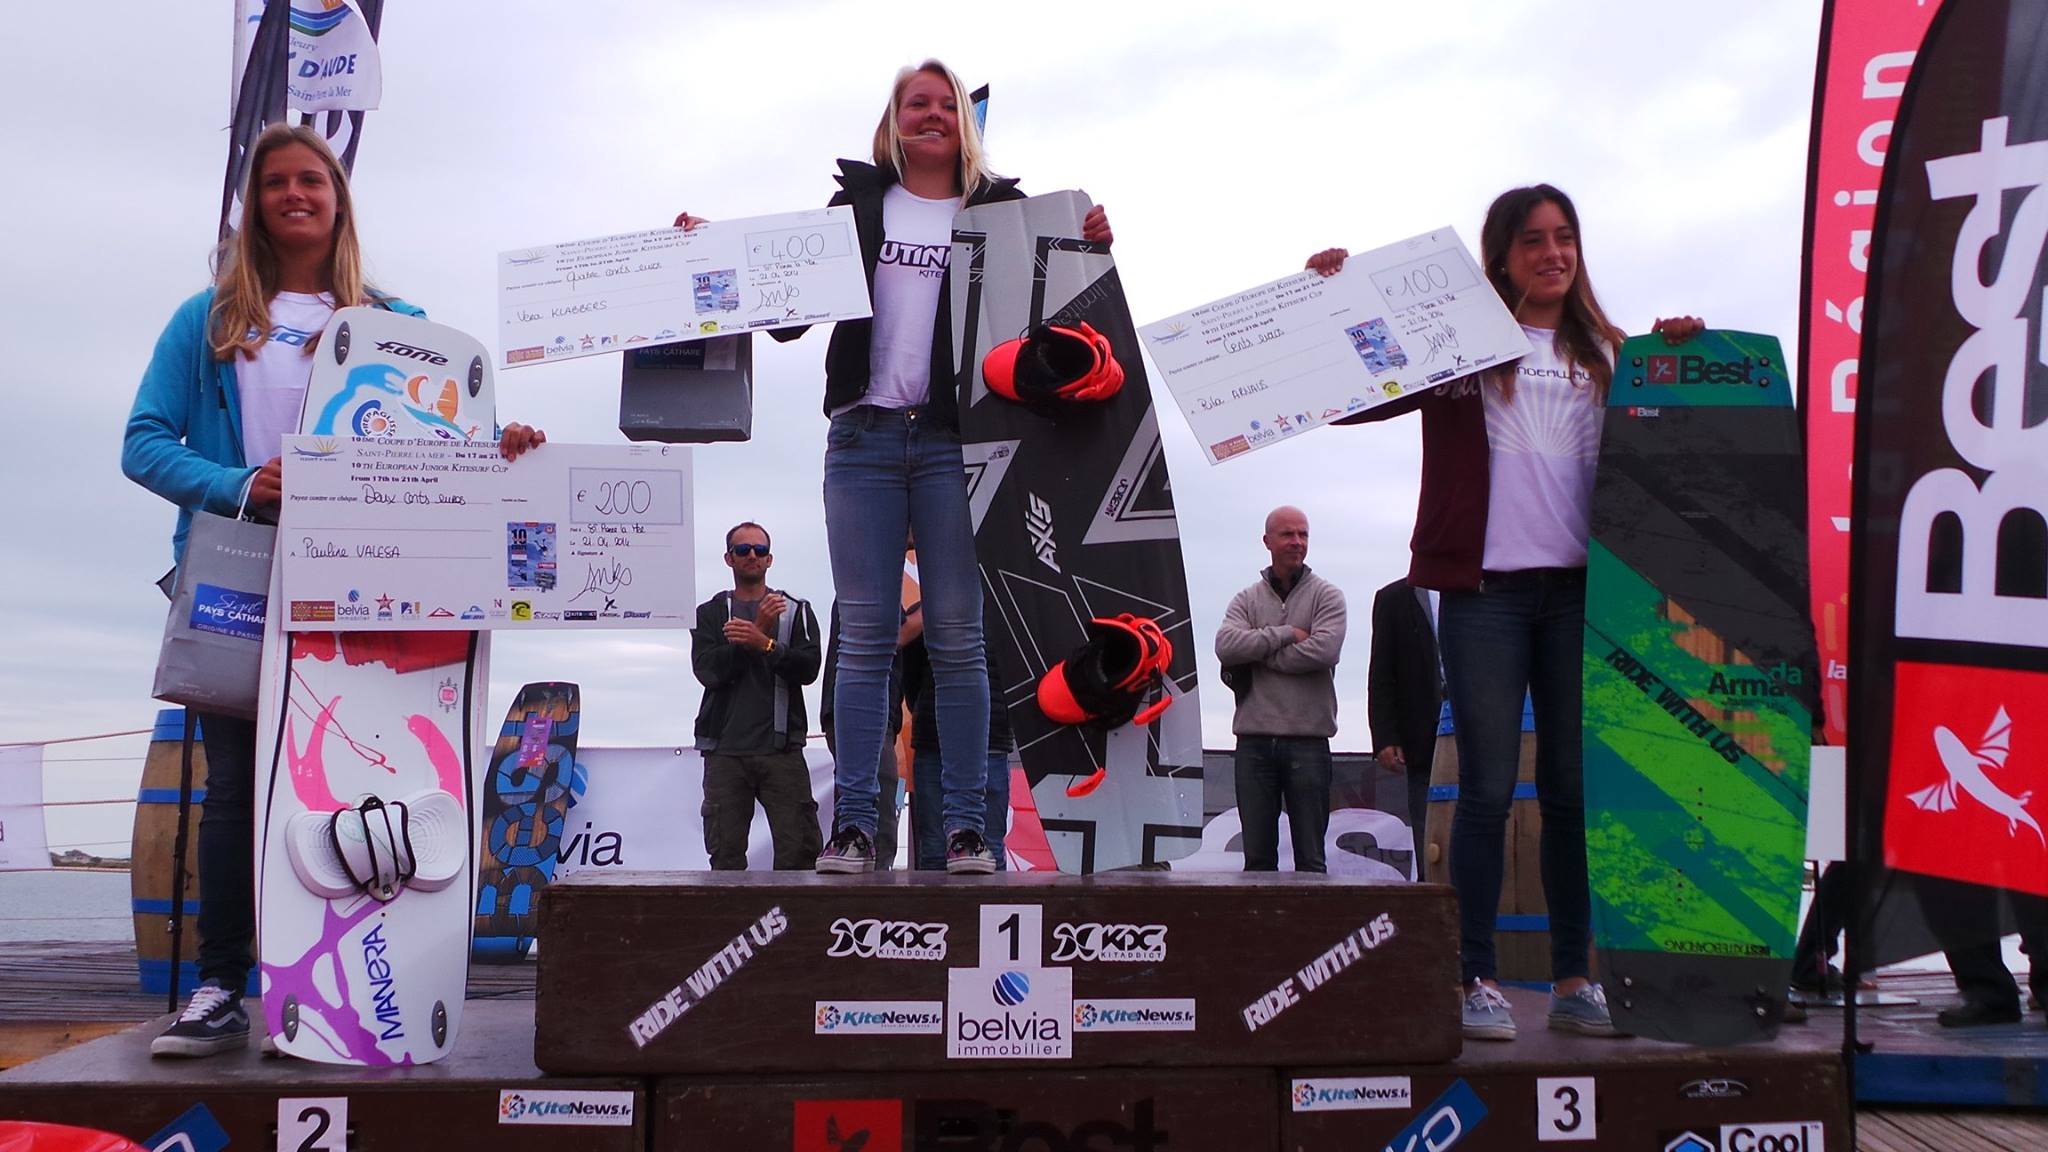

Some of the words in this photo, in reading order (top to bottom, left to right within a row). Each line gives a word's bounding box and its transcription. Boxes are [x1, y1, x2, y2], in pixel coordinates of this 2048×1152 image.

[771, 232, 825, 261] 400
[879, 241, 951, 268] UTIN
[919, 269, 944, 279] KITE
[1401, 263, 1448, 297] 100
[551, 300, 608, 318] KLABBERS
[1680, 355, 1754, 384] Best
[1895, 116, 2048, 649] Best
[1637, 407, 1660, 417] Best
[377, 436, 405, 446] COUPE
[407, 438, 449, 448] D'EUROPE
[375, 461, 418, 471] EUROPEAN
[420, 462, 449, 472] JUNIOR
[451, 463, 489, 473] KITESURF
[491, 464, 509, 473] CUP
[373, 475, 389, 483] 17th
[420, 477, 439, 485] April
[595, 480, 651, 515] 200
[302, 537, 349, 558] Pauline
[198, 603, 225, 618] PAYS
[227, 608, 266, 625] CATHAR
[337, 603, 370, 616] belvia
[196, 623, 229, 636] ORIGINE
[236, 629, 264, 641] PASSIO
[1605, 647, 1662, 693] RIDE
[1656, 686, 1720, 738] WITH
[1710, 731, 1747, 764] US
[555, 821, 624, 866] via
[998, 912, 1020, 961] 1
[879, 949, 942, 958] KITADDICT
[1101, 951, 1163, 959] KITADDICT
[629, 985, 690, 1048] RIDE
[686, 934, 753, 999] WITH
[749, 905, 788, 946] US
[1242, 977, 1301, 1033] RIDE
[1296, 935, 1362, 993] WITH
[1359, 912, 1396, 949] US
[842, 1010, 942, 1026] KiteNews.fr
[957, 1011, 1062, 1042] belvia
[1100, 1009, 1194, 1024] KiteNews.fr
[957, 1043, 1062, 1057] immobilier
[1318, 1086, 1409, 1103] KiteNews.fr
[528, 1100, 631, 1117] KiteNews.fr
[1553, 1086, 1582, 1132] 3
[295, 1106, 332, 1152] 2
[1728, 1125, 1810, 1152] Cool
